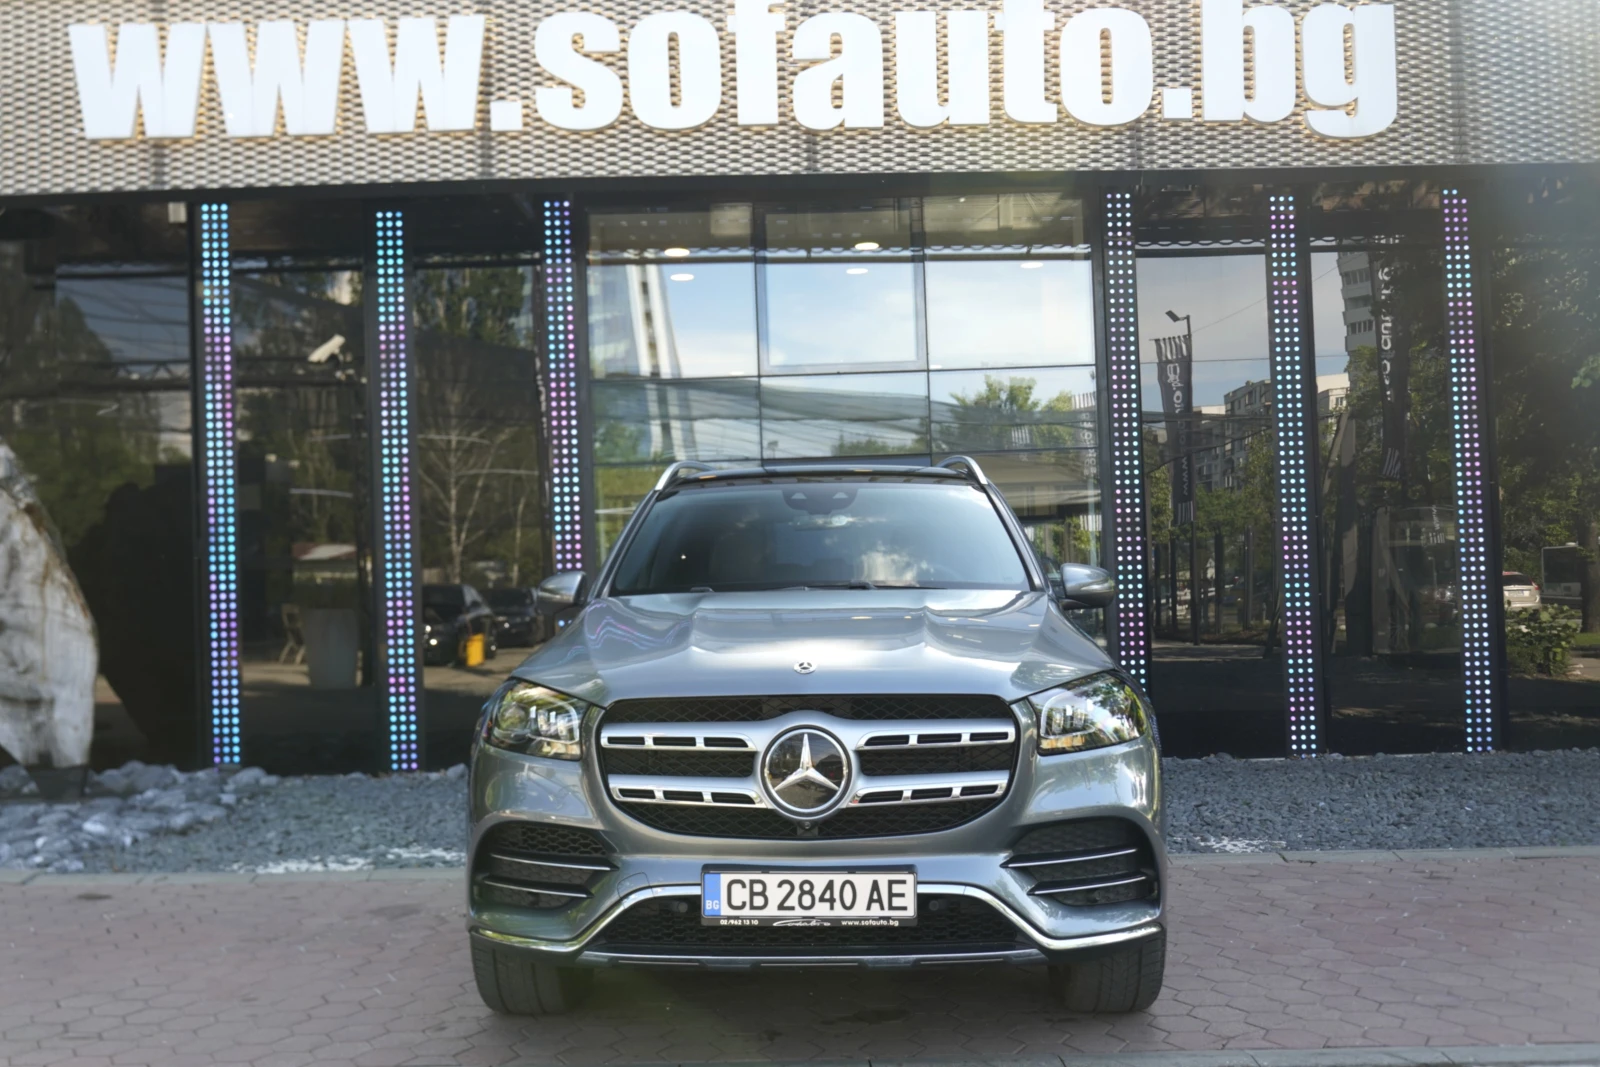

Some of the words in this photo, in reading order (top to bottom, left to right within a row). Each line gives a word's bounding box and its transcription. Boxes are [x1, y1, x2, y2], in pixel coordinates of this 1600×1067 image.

[66, 0, 1398, 139] www.sofauto.bg
[705, 900, 720, 910] BG
[726, 879, 769, 911] CB
[776, 879, 858, 911] 2840
[865, 879, 908, 911] AE
[840, 919, 899, 927] www.sofauto.bg
